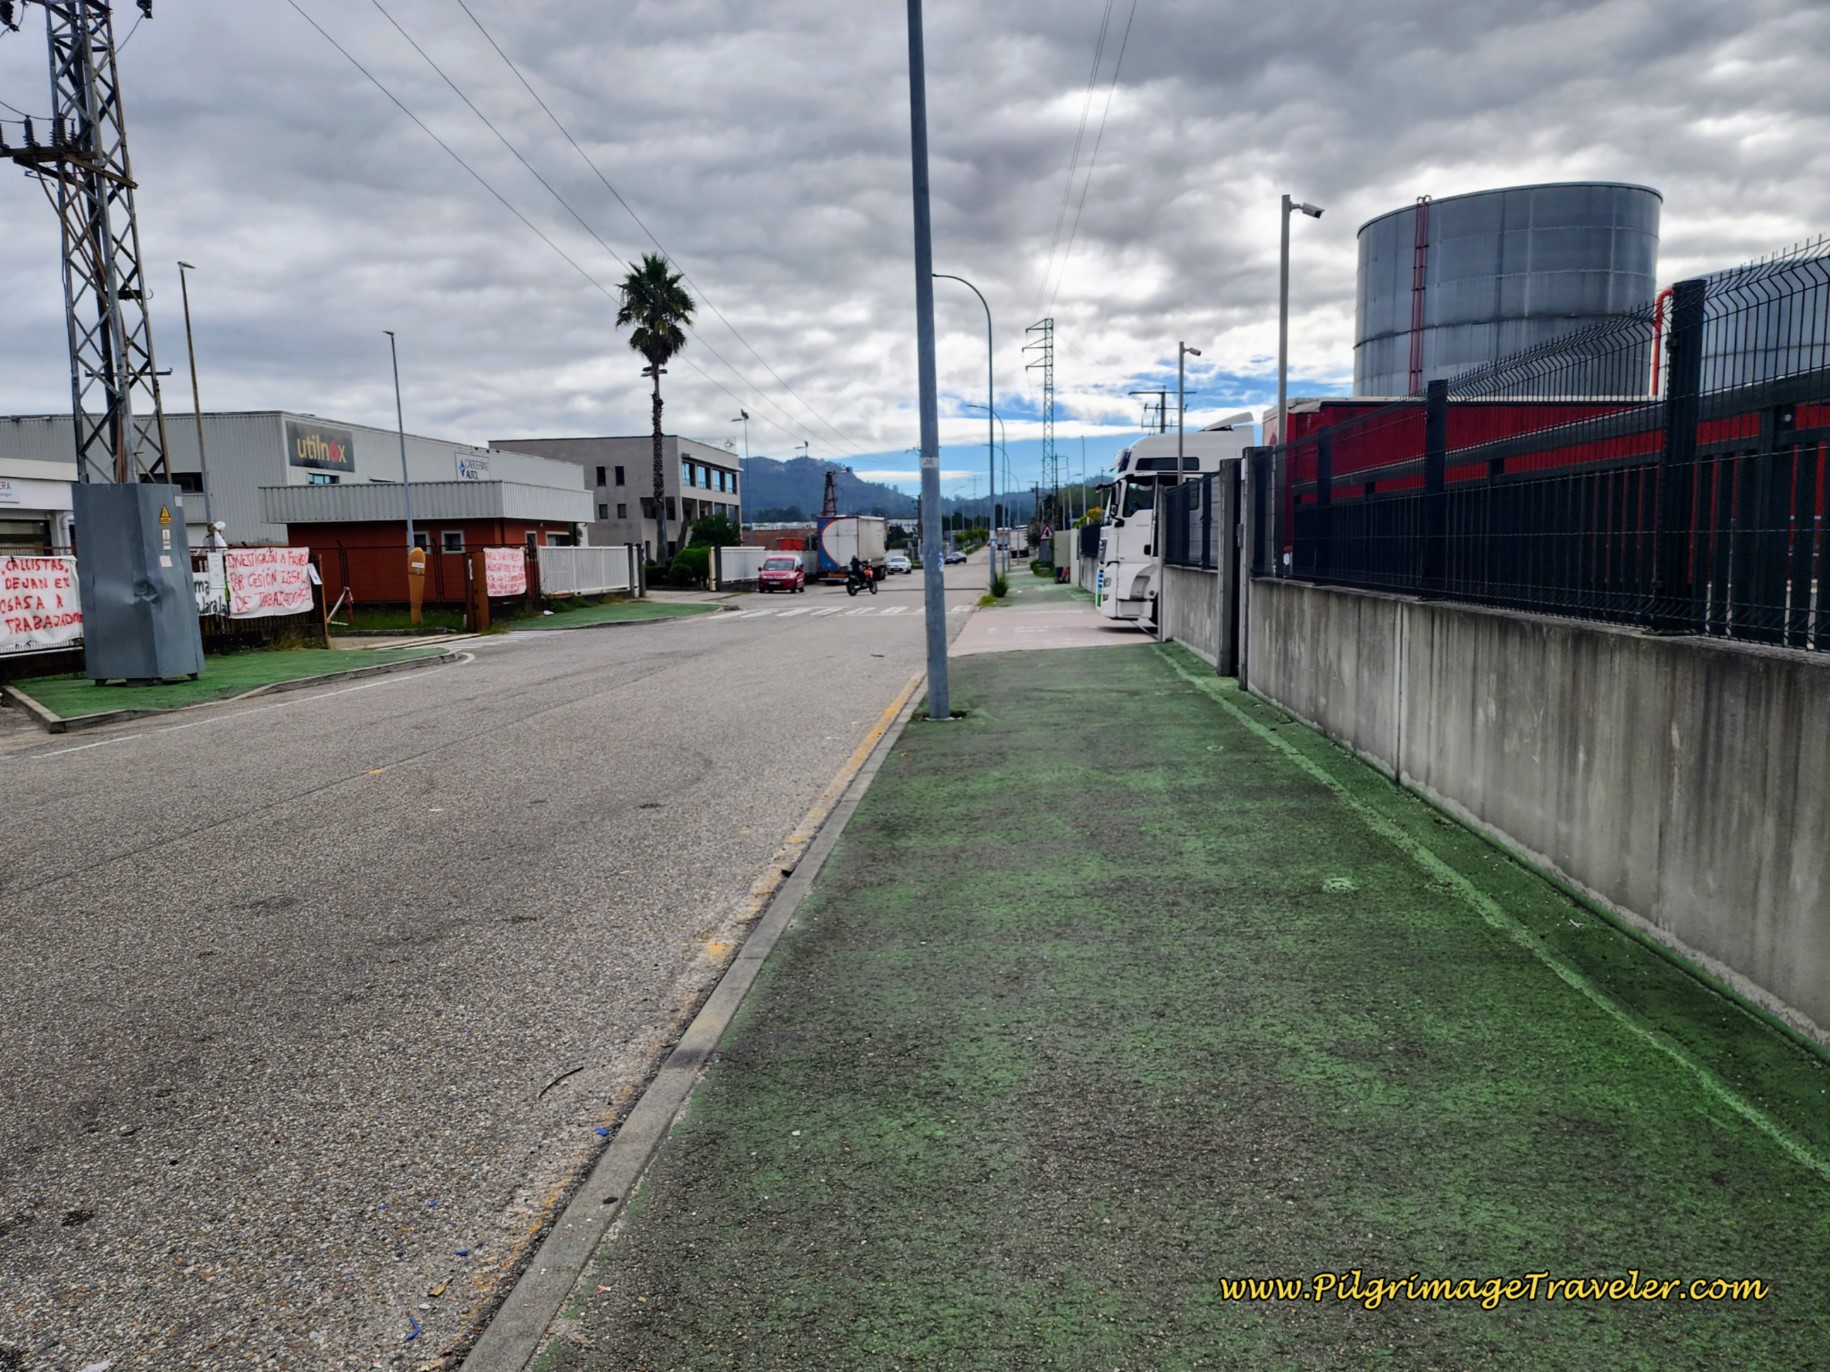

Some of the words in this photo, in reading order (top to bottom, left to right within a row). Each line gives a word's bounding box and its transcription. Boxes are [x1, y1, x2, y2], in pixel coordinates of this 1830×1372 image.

[297, 434, 347, 463] utilnox
[5, 578, 48, 590] DEJAN
[235, 595, 251, 612] DE
